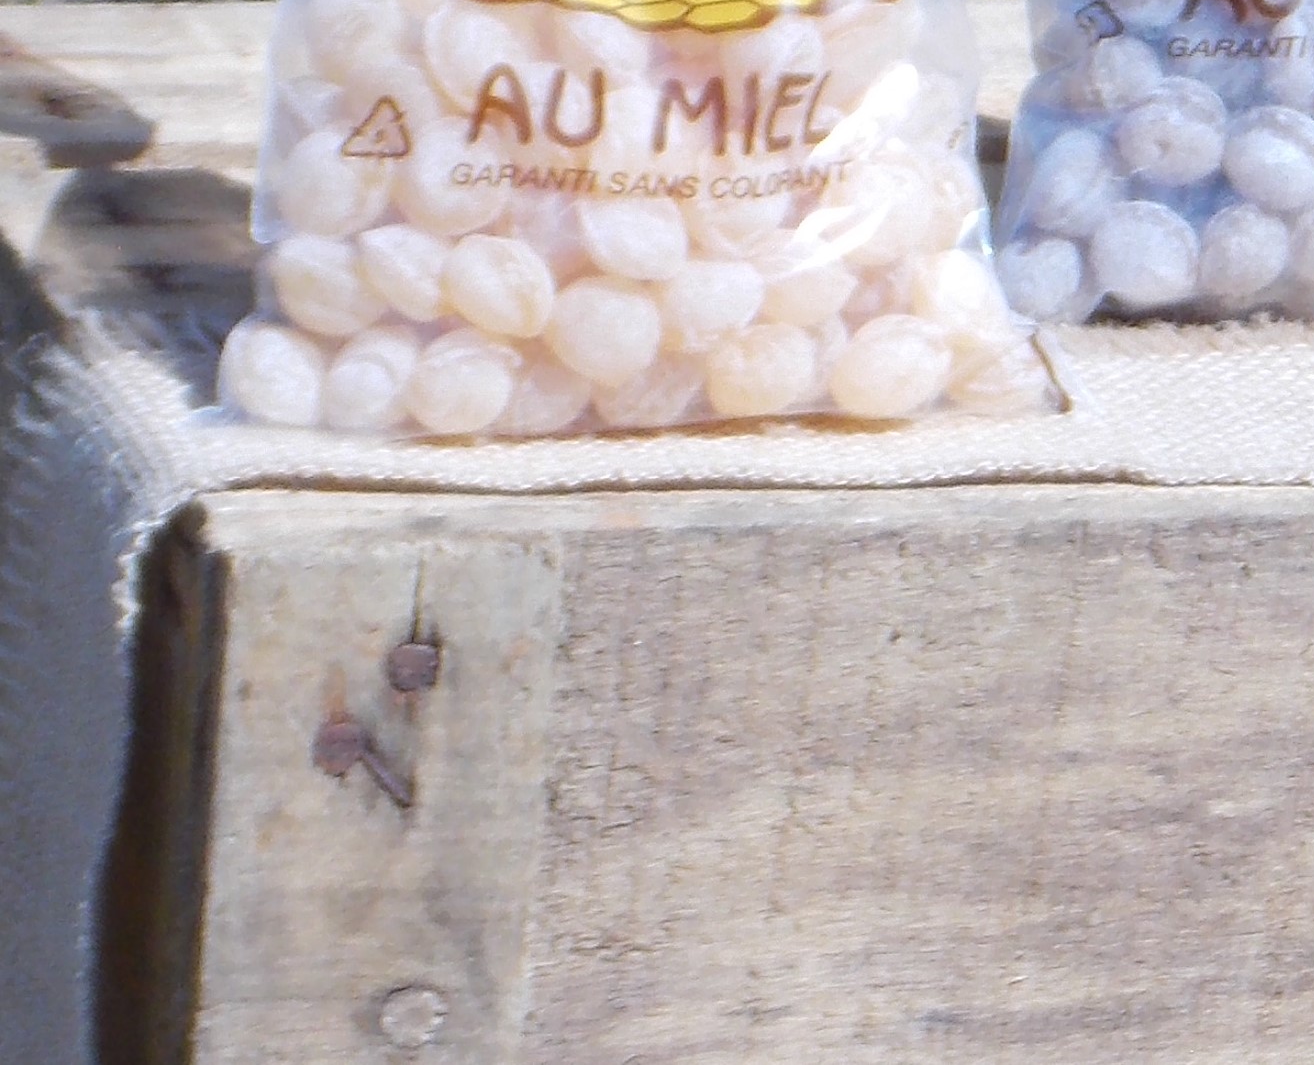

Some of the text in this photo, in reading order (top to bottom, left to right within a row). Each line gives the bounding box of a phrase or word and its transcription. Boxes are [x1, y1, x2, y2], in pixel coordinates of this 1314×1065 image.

[1166, 35, 1305, 59] GARANTI
[467, 62, 834, 156] AU MIEL
[451, 161, 598, 193] GARANTI
[609, 172, 701, 200] SANS
